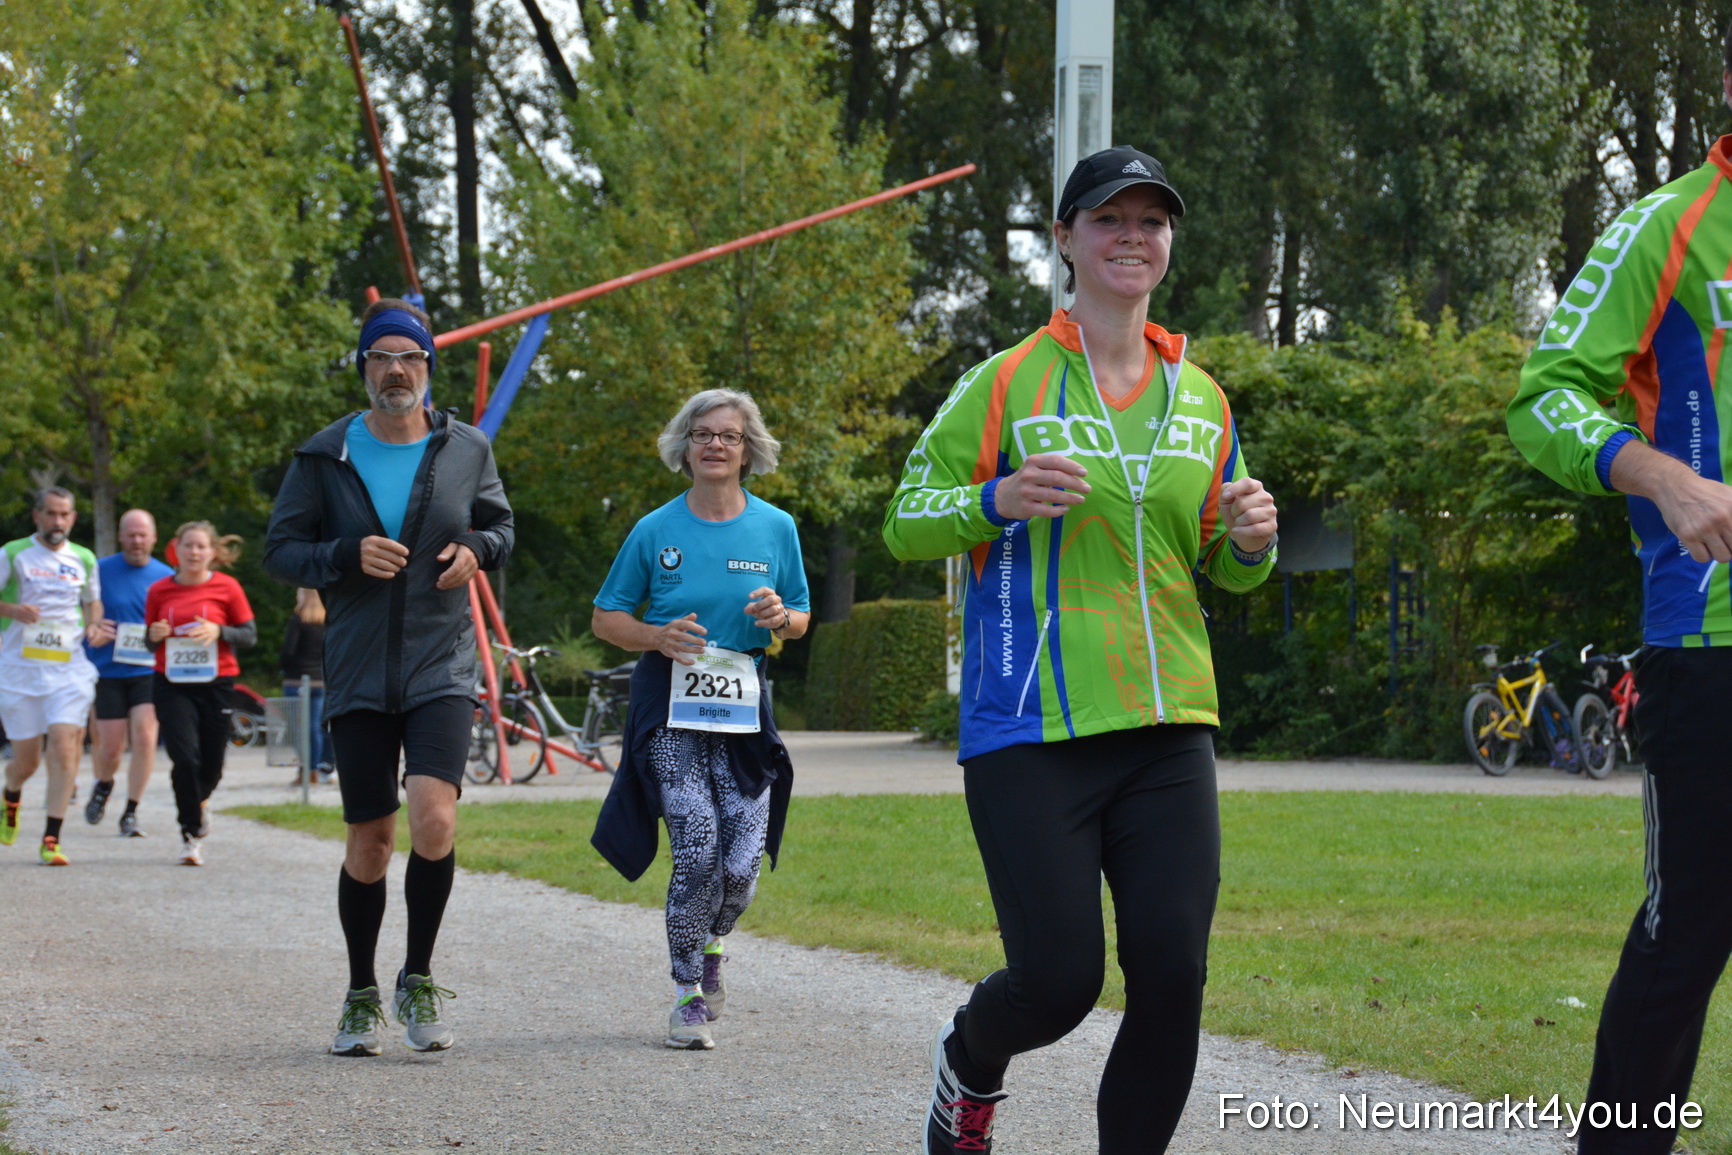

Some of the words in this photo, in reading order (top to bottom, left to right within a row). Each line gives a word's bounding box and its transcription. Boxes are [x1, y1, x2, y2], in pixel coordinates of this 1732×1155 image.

[1122, 167, 1152, 177] adidas
[727, 559, 770, 573] BOCK
[998, 521, 1019, 677] www.bockonline.de
[35, 632, 62, 647] 404
[173, 650, 209, 665] 2328
[684, 672, 743, 700] 2321
[699, 706, 731, 719] Brigitte
